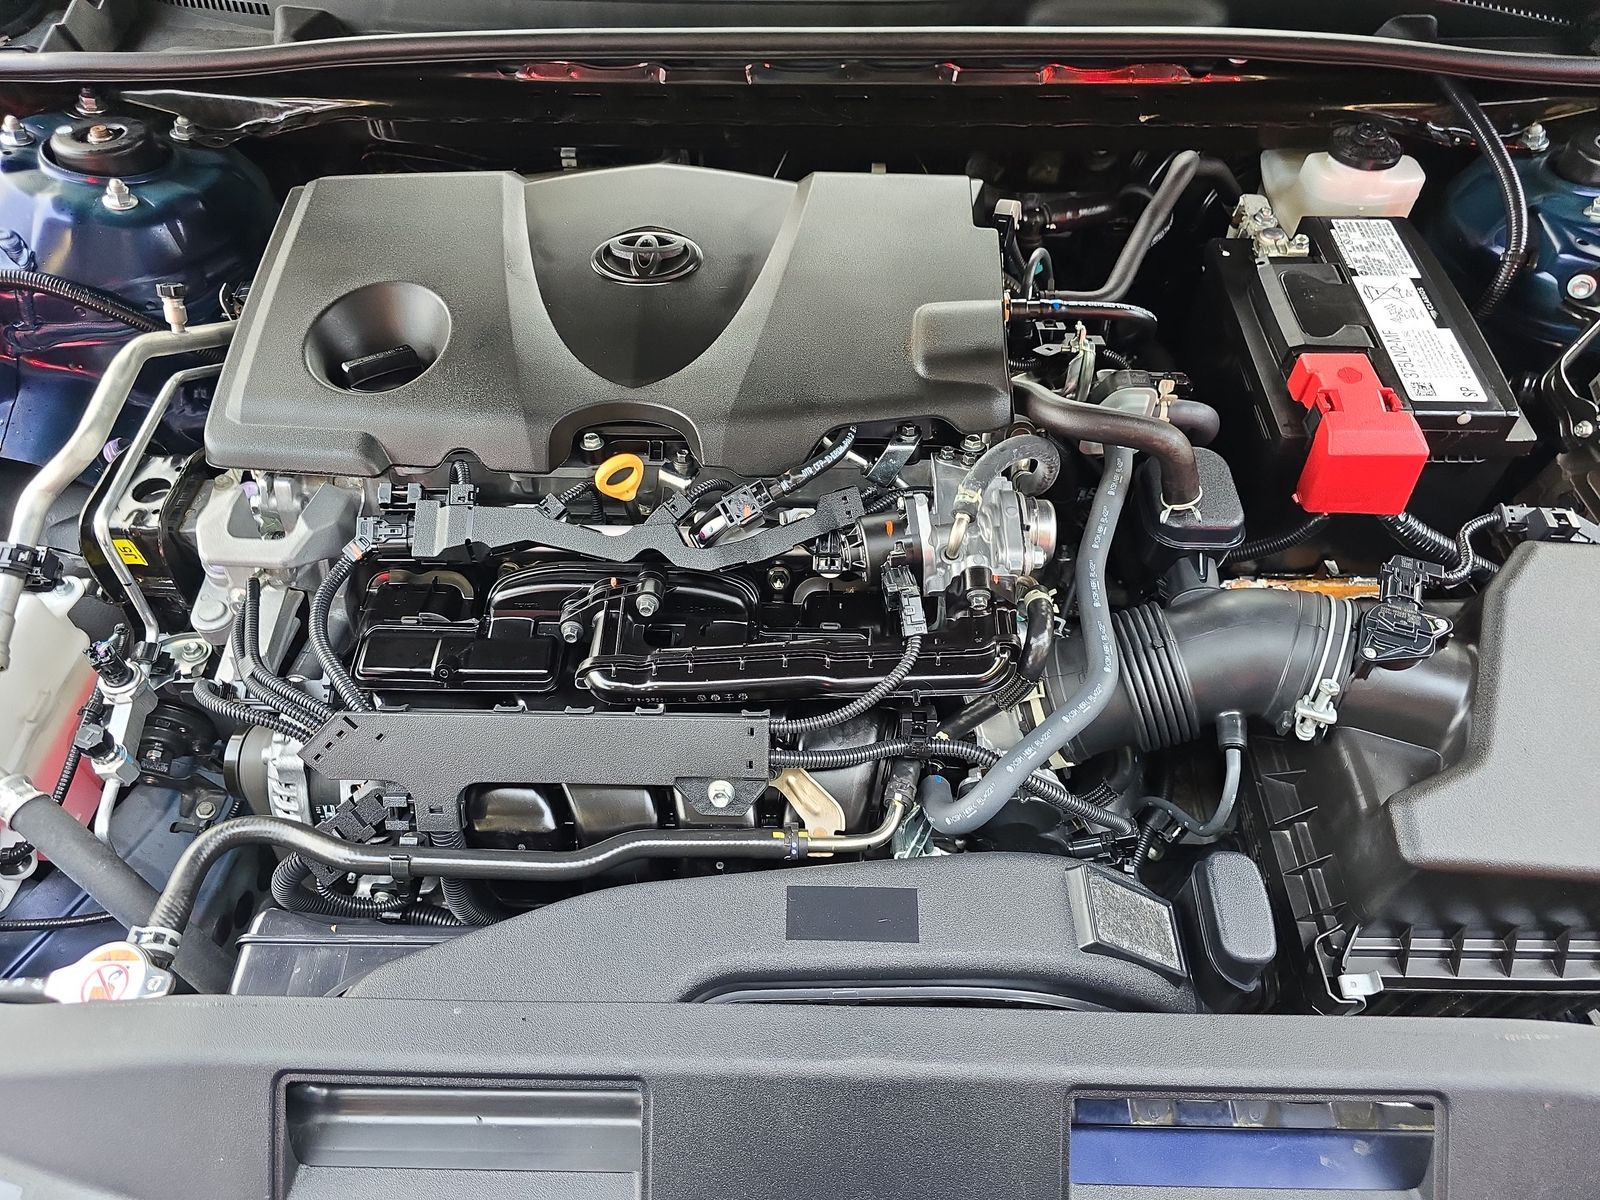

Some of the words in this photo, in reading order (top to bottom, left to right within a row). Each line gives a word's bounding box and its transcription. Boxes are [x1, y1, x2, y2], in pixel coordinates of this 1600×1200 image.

[1417, 286, 1434, 311] CLARIOS
[1381, 330, 1420, 379] 375LN2-MF
[1459, 386, 1479, 398] SP
[117, 546, 138, 560] J5
